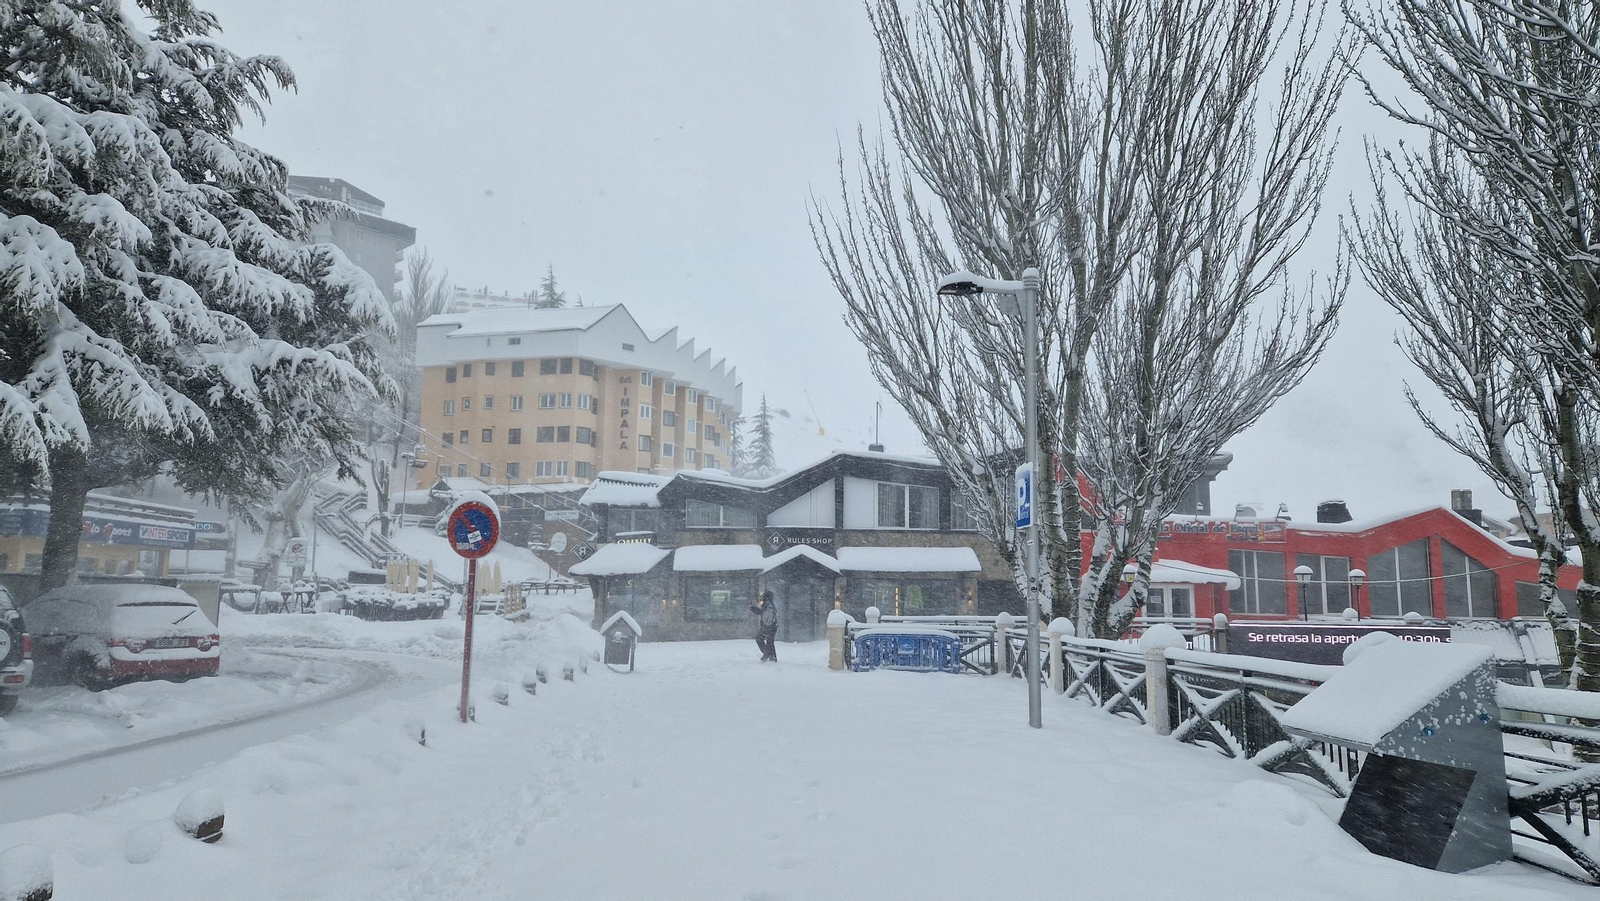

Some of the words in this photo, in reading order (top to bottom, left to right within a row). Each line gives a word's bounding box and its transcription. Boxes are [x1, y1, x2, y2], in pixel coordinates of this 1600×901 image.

[620, 387, 630, 450] IMPALA
[1018, 478, 1026, 521] P
[1213, 522, 1226, 532] de
[1248, 632, 1264, 643] Se
[1266, 633, 1309, 643] retrasa
[1311, 633, 1322, 643] la
